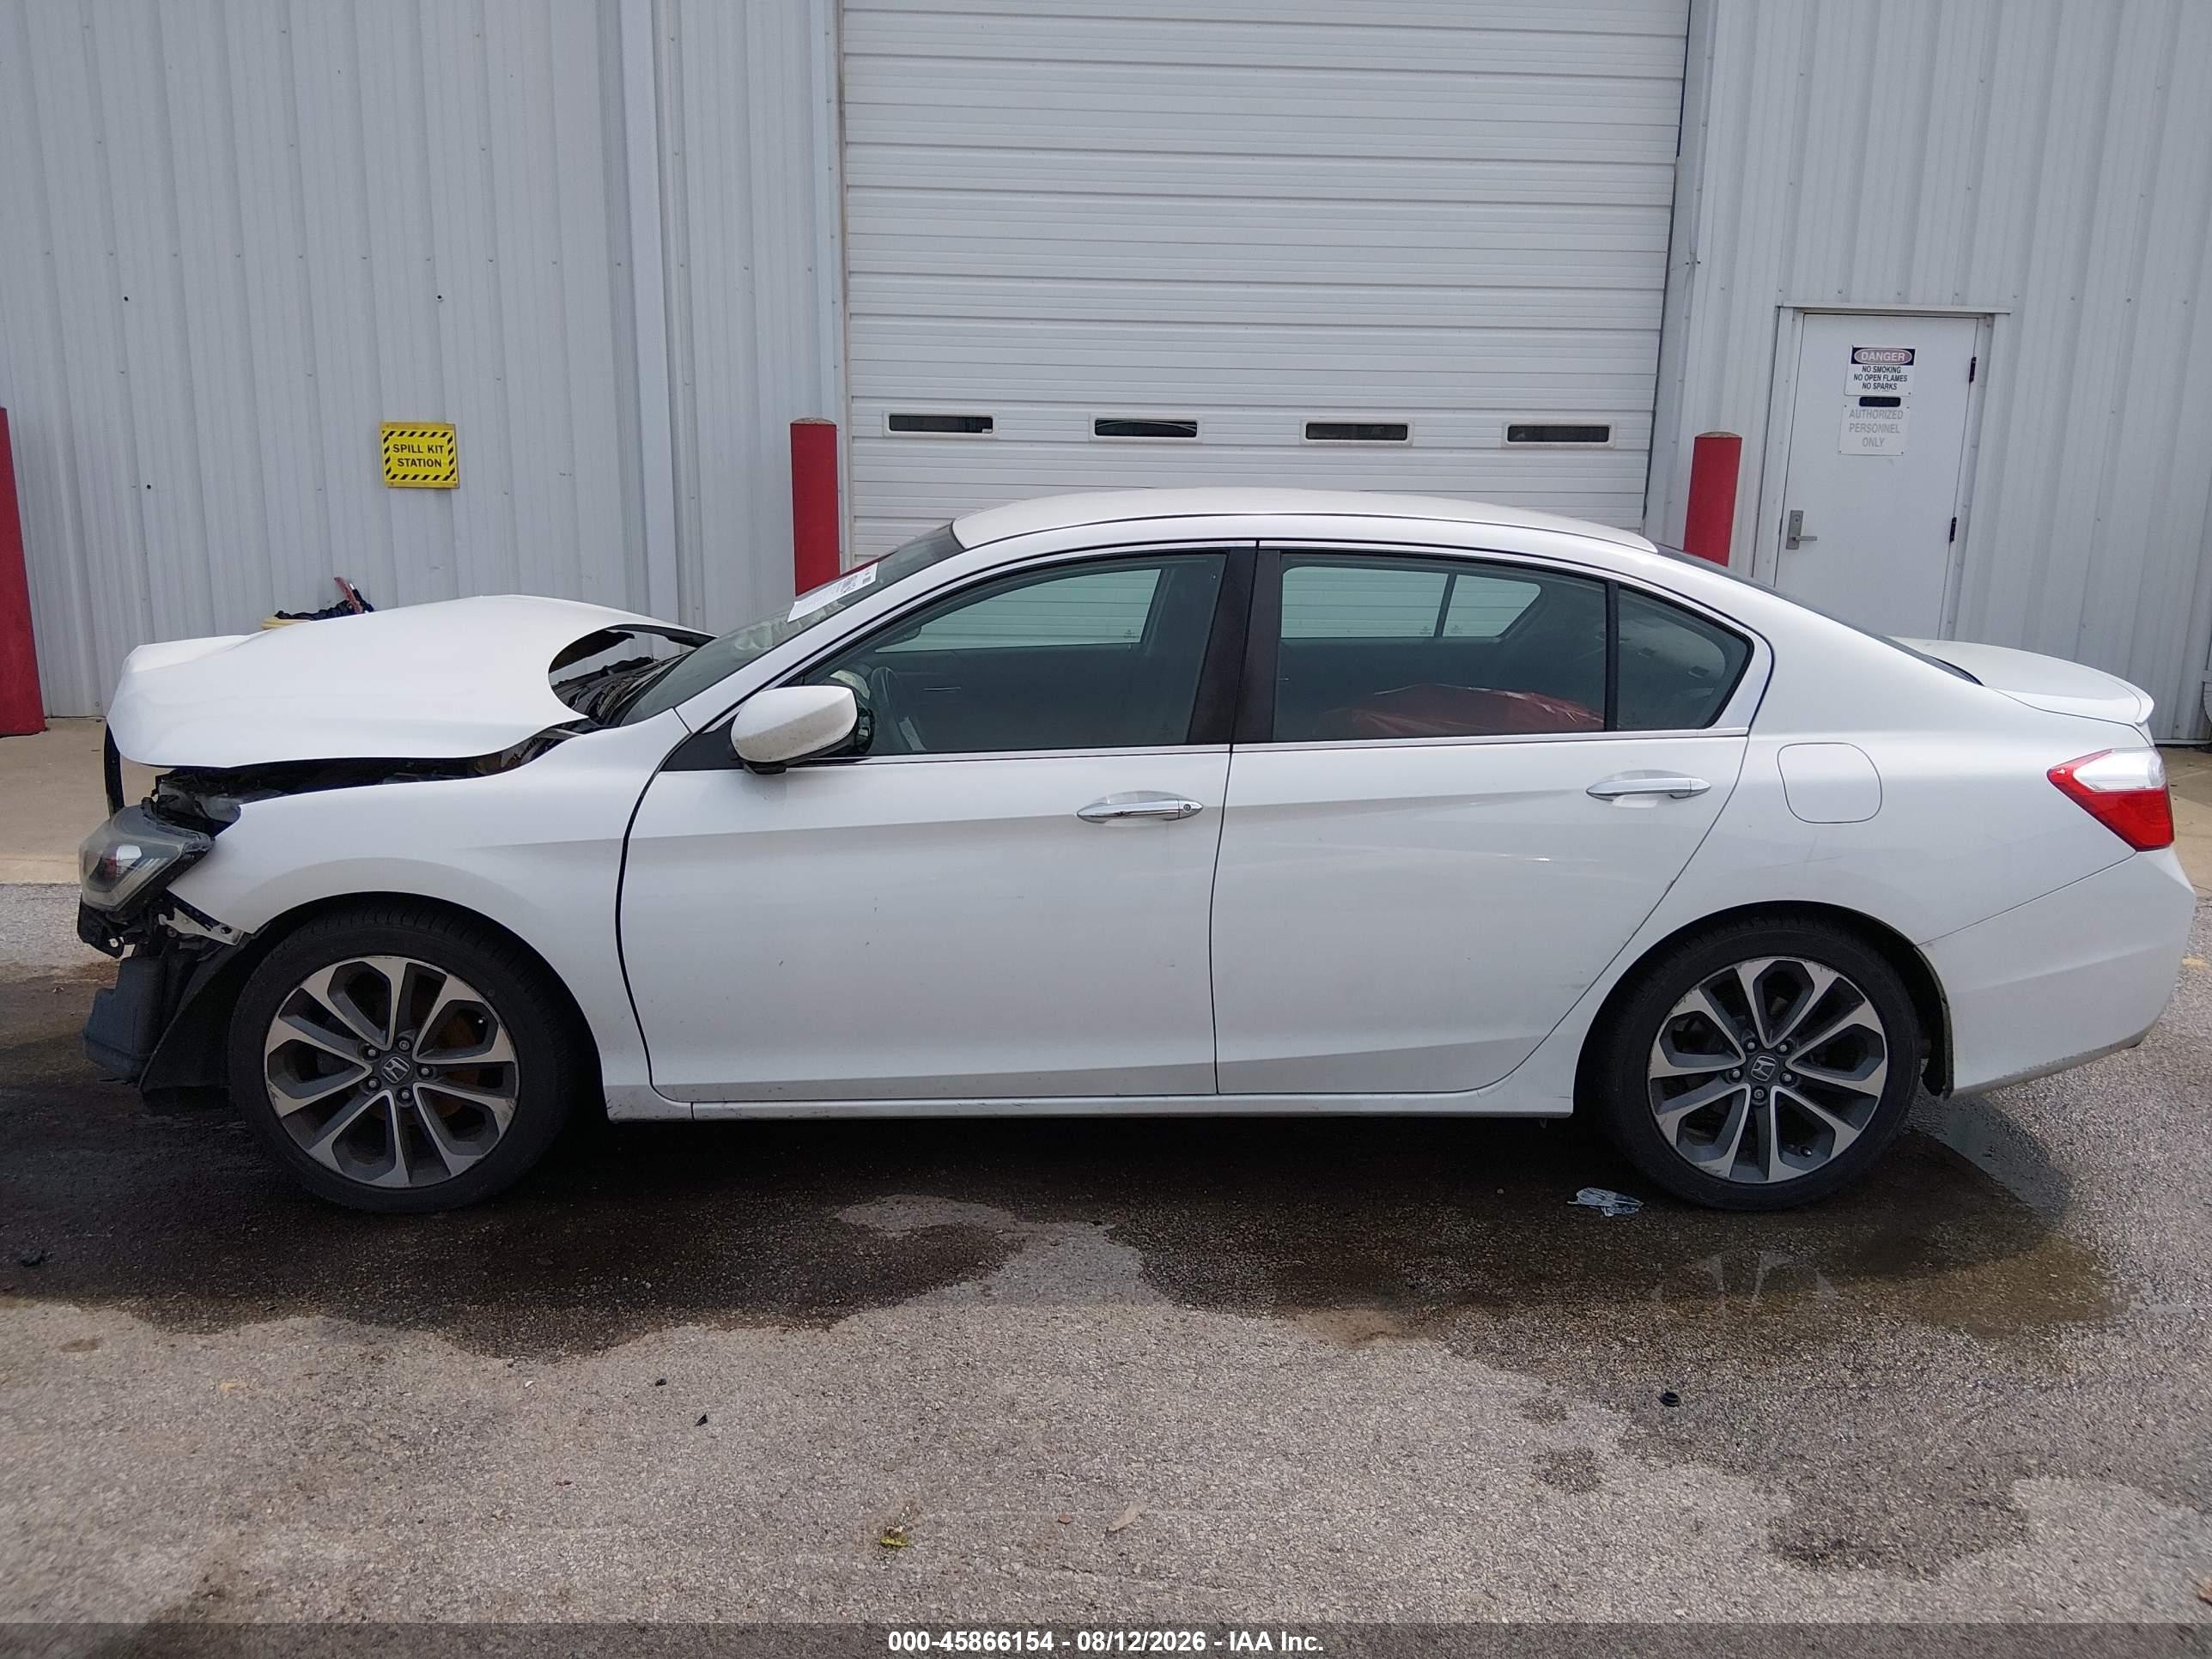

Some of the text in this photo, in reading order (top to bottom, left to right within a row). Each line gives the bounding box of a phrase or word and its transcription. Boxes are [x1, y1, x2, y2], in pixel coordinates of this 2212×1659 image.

[1861, 351, 1905, 361] DANGER
[1849, 410, 1904, 419] AUTHORIZED
[1849, 423, 1900, 433] PERSONNEL
[1862, 437, 1885, 447] ONLY
[392, 444, 444, 453] SPILL KIT
[398, 458, 442, 468] STATION
